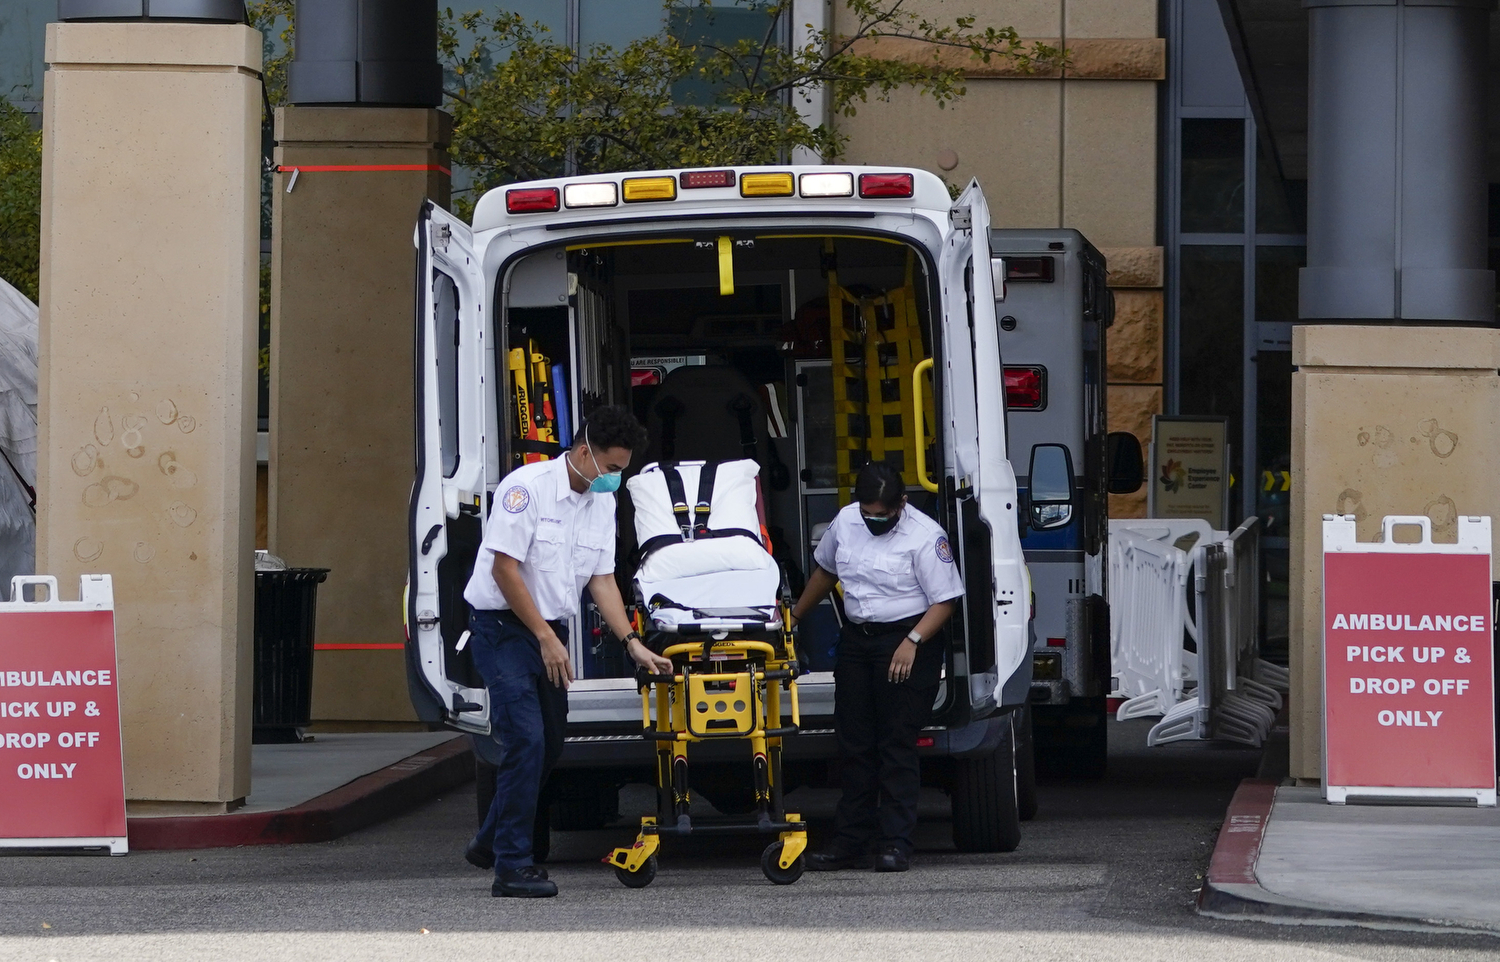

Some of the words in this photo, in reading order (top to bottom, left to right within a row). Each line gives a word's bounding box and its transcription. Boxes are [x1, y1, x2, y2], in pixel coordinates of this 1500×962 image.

[518, 388, 529, 436] RUGGED
[1331, 613, 1486, 632] AMBULANCE
[1346, 645, 1405, 663] PICK
[1412, 646, 1446, 663] UP
[1453, 647, 1472, 664] &
[1349, 678, 1416, 695] DROP
[1423, 678, 1470, 696] OFF
[46, 701, 77, 717] UP
[84, 701, 101, 717] &
[1377, 710, 1443, 727] ONLY
[57, 731, 100, 748] OFF
[17, 762, 77, 780] ONLY
